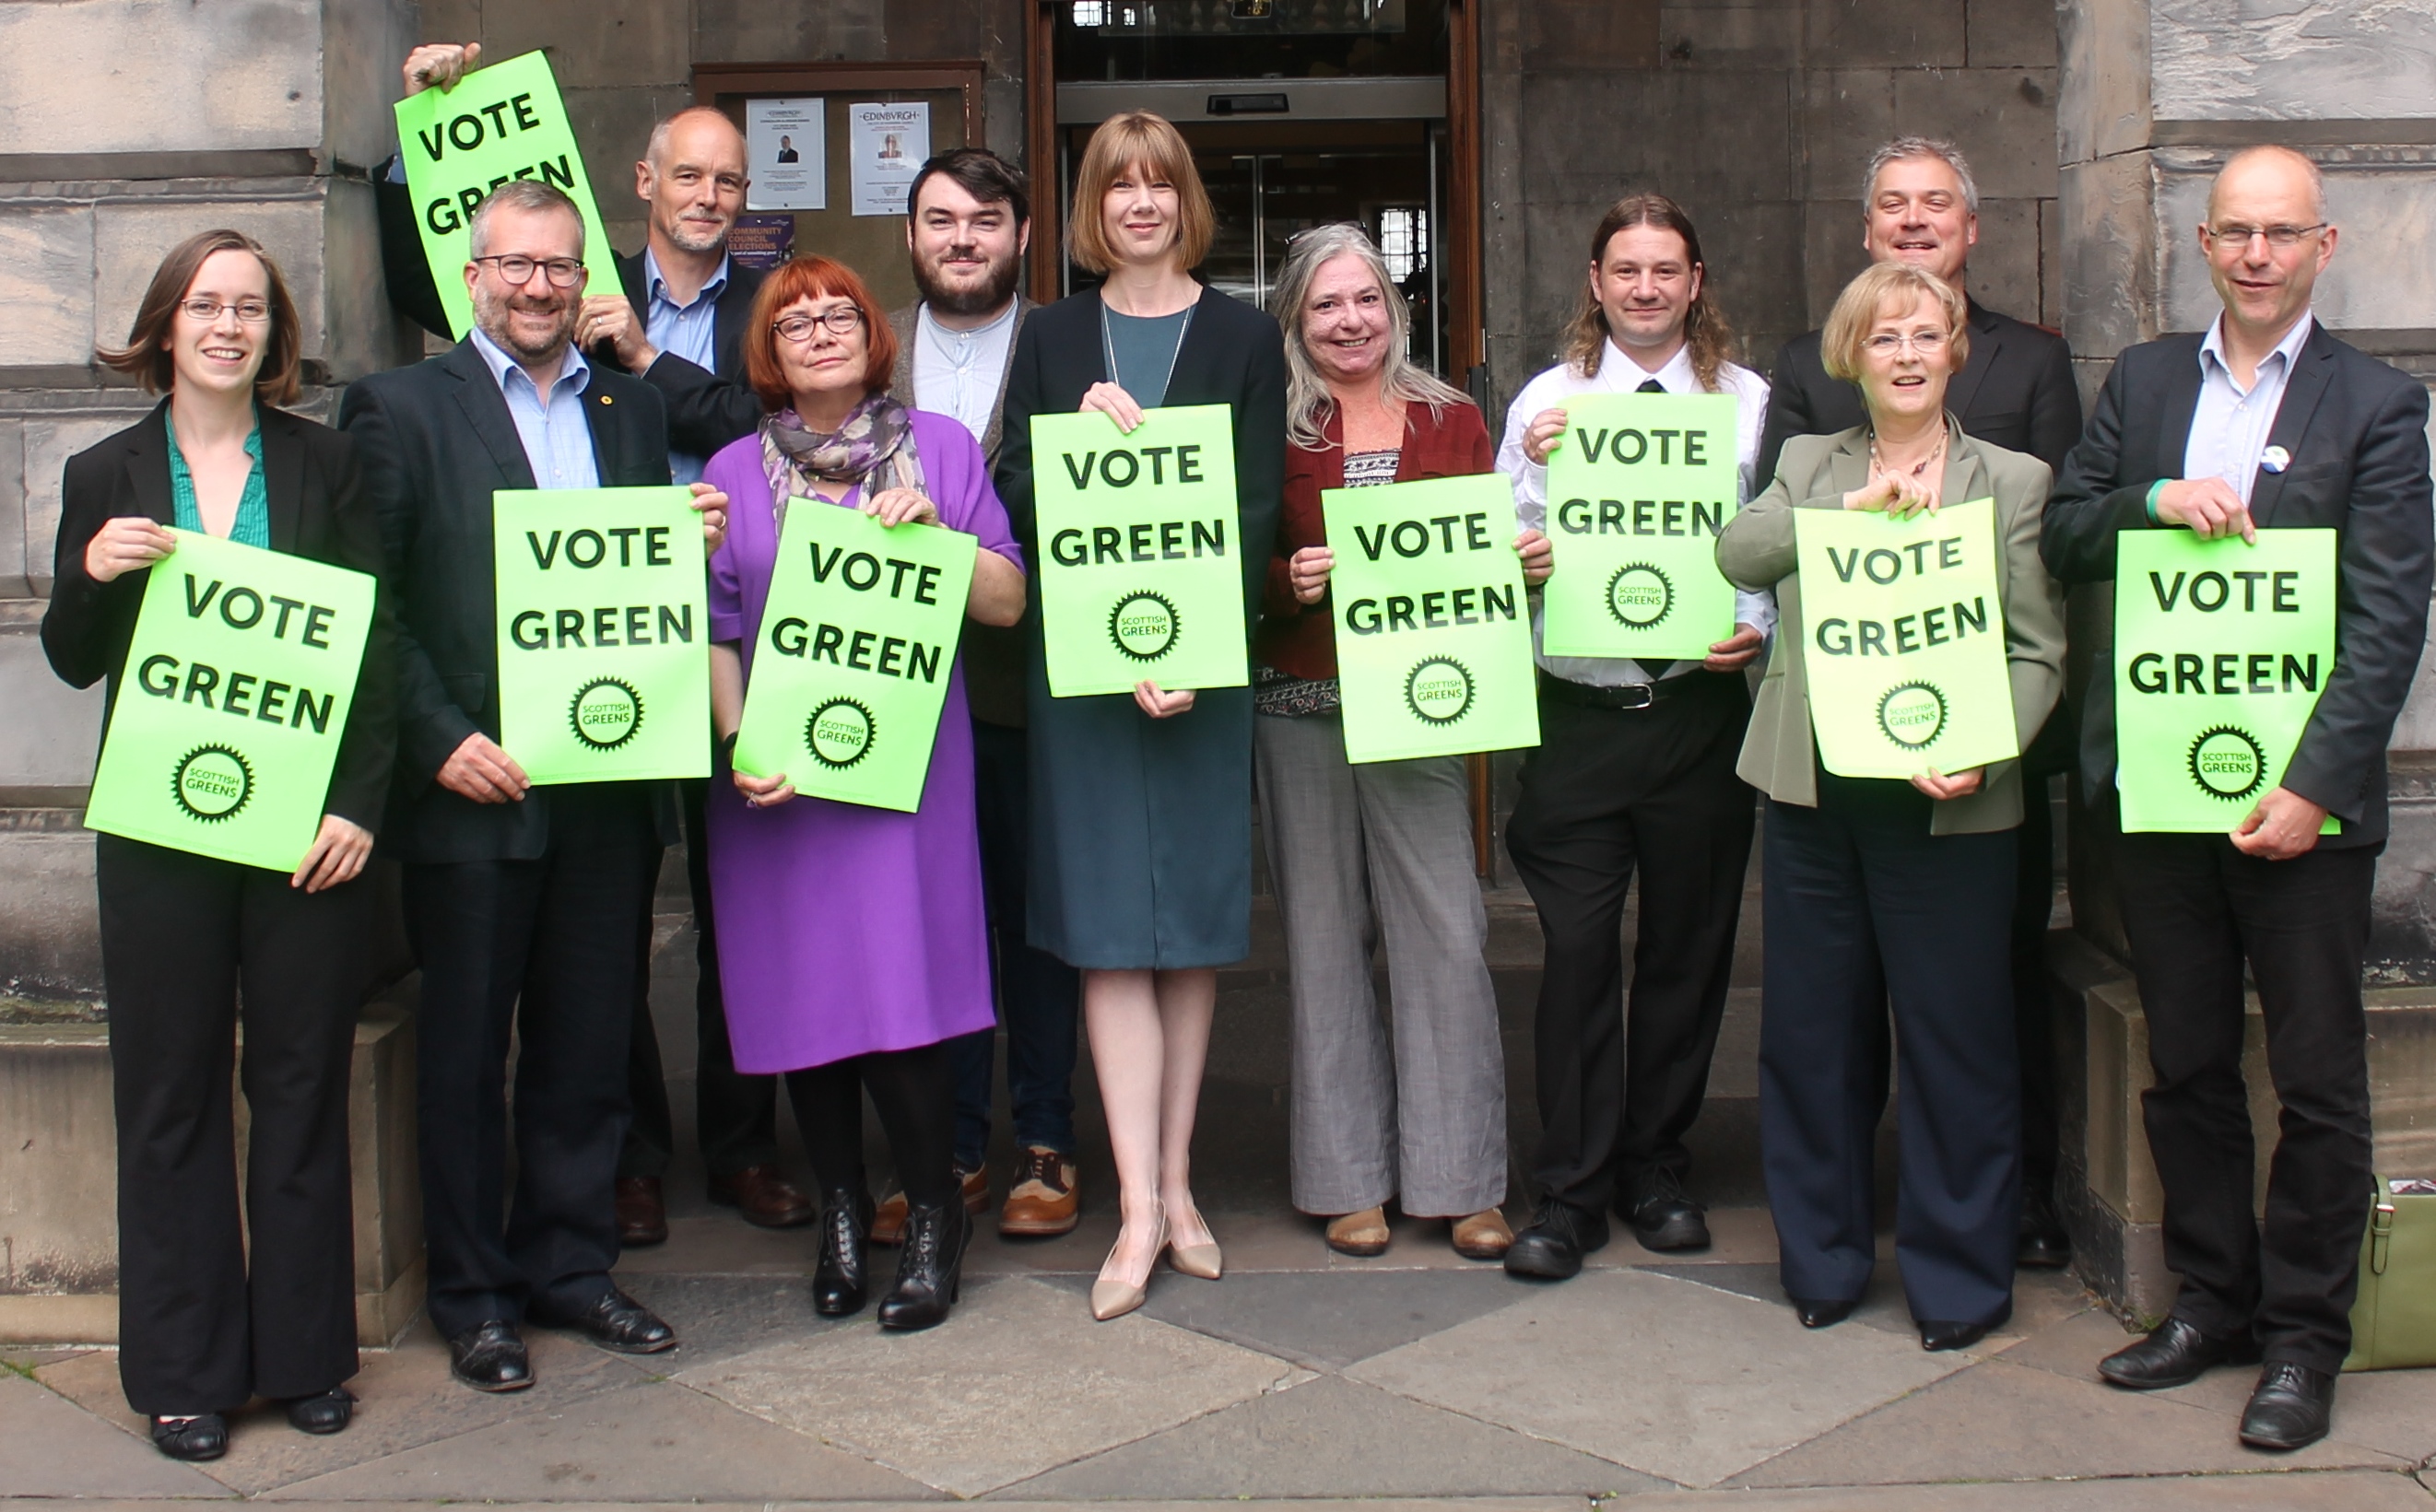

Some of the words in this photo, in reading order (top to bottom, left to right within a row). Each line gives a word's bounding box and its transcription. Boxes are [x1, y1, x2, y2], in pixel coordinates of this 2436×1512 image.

[418, 92, 540, 161] VOTE
[427, 154, 575, 235] GRN
[728, 242, 777, 251] ELECTIONS
[1576, 428, 1707, 464] VOTE
[1062, 445, 1204, 490] VOTE
[1558, 498, 1723, 537] GREEN
[526, 526, 673, 570] VOTE
[1050, 520, 1225, 567] GREEN
[1353, 512, 1491, 561] VOTE
[810, 542, 942, 606] VOTE
[1826, 536, 1962, 584] VOTE
[1618, 586, 1661, 594] SCOTTISH
[1618, 595, 1662, 605] GREENS
[2148, 570, 2300, 613] VOTE
[184, 572, 335, 649] VOTE
[510, 604, 692, 651] GREEN
[1121, 615, 1167, 626] SCOTTISH
[1346, 583, 1516, 635] GREEN
[1817, 597, 1986, 656] GREEN
[1121, 625, 1168, 637] GREENS
[771, 616, 942, 684] GREEN
[1418, 680, 1462, 690] SCOTTISH
[2129, 652, 2318, 695] GREEN
[138, 654, 335, 734] GREEN
[583, 703, 630, 713] SCOTTISH
[1417, 688, 1463, 701] GREENS
[583, 713, 630, 725] GREENS
[819, 720, 865, 735] SCOTTISH
[1889, 710, 1936, 726] GREENS
[817, 729, 863, 746] GREENS
[2202, 753, 2252, 761] SCOTTISH
[2202, 762, 2253, 773] GREENS
[185, 778, 238, 799] GREENS
[188, 768, 240, 786] SCOTTISH
